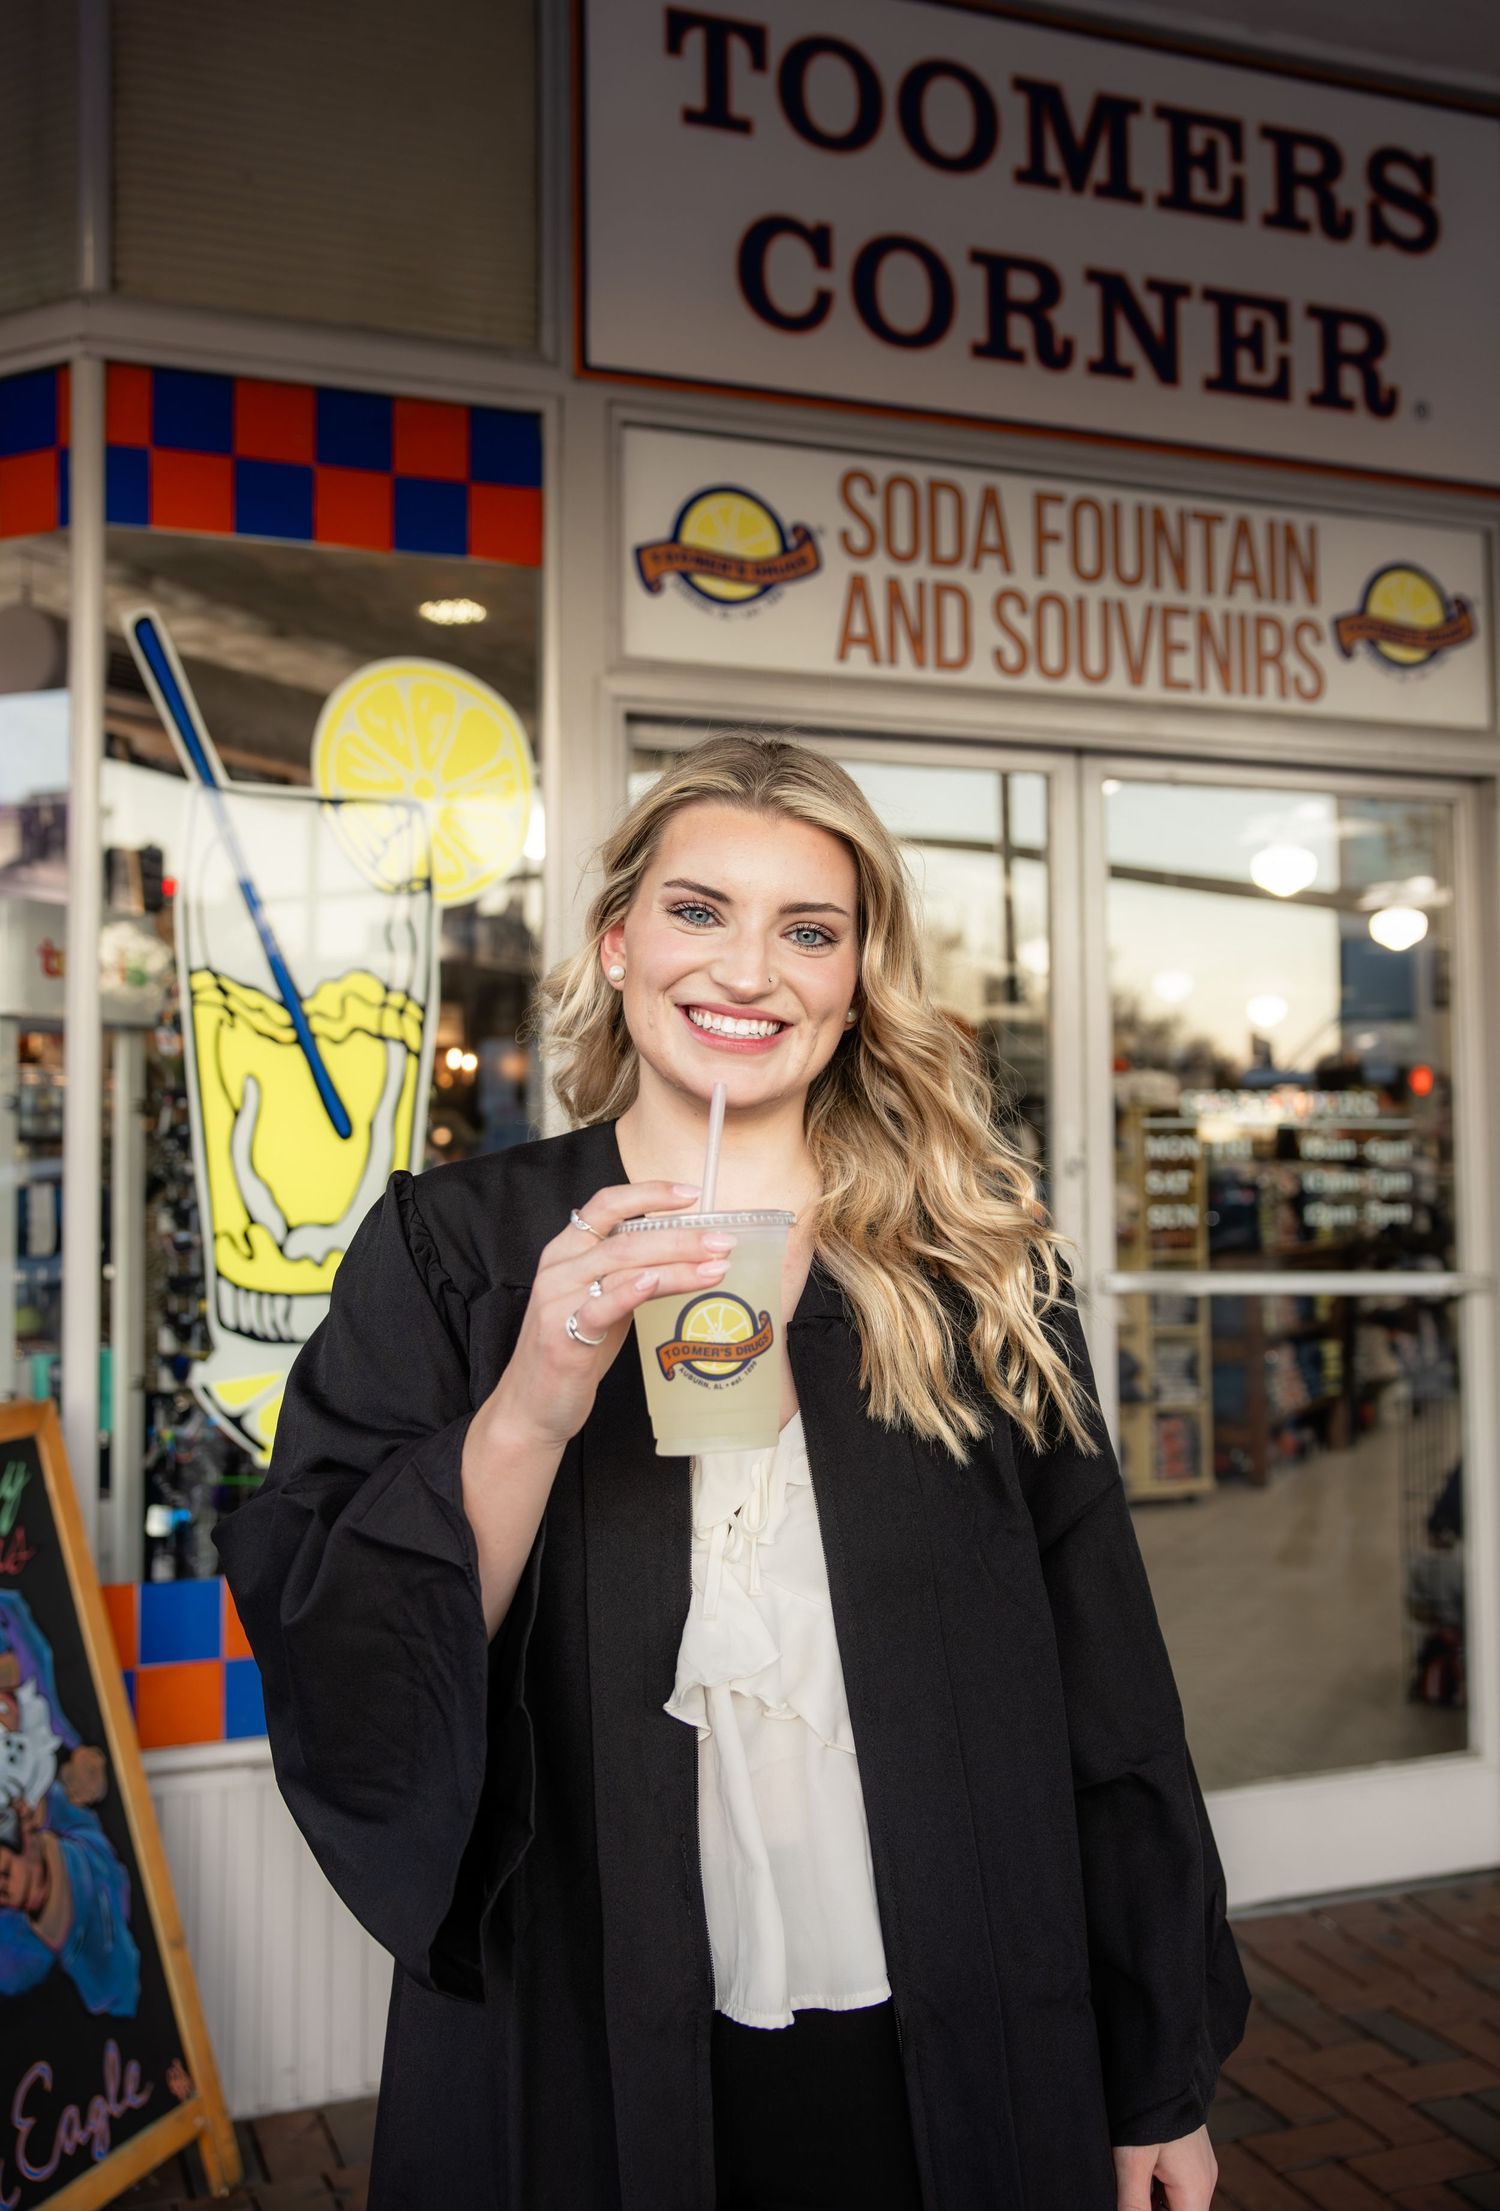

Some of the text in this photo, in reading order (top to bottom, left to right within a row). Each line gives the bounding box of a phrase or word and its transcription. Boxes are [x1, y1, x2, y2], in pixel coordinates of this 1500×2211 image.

[664, 6, 1441, 255] TOOMERS
[735, 213, 1401, 420] CORNER
[838, 468, 1320, 607] SODA FOUNTAIN
[836, 572, 1327, 702] AND SOUVENIRS
[664, 1332, 770, 1360] TOOMER'S DRUGS
[11, 2037, 155, 2183] Eagle
